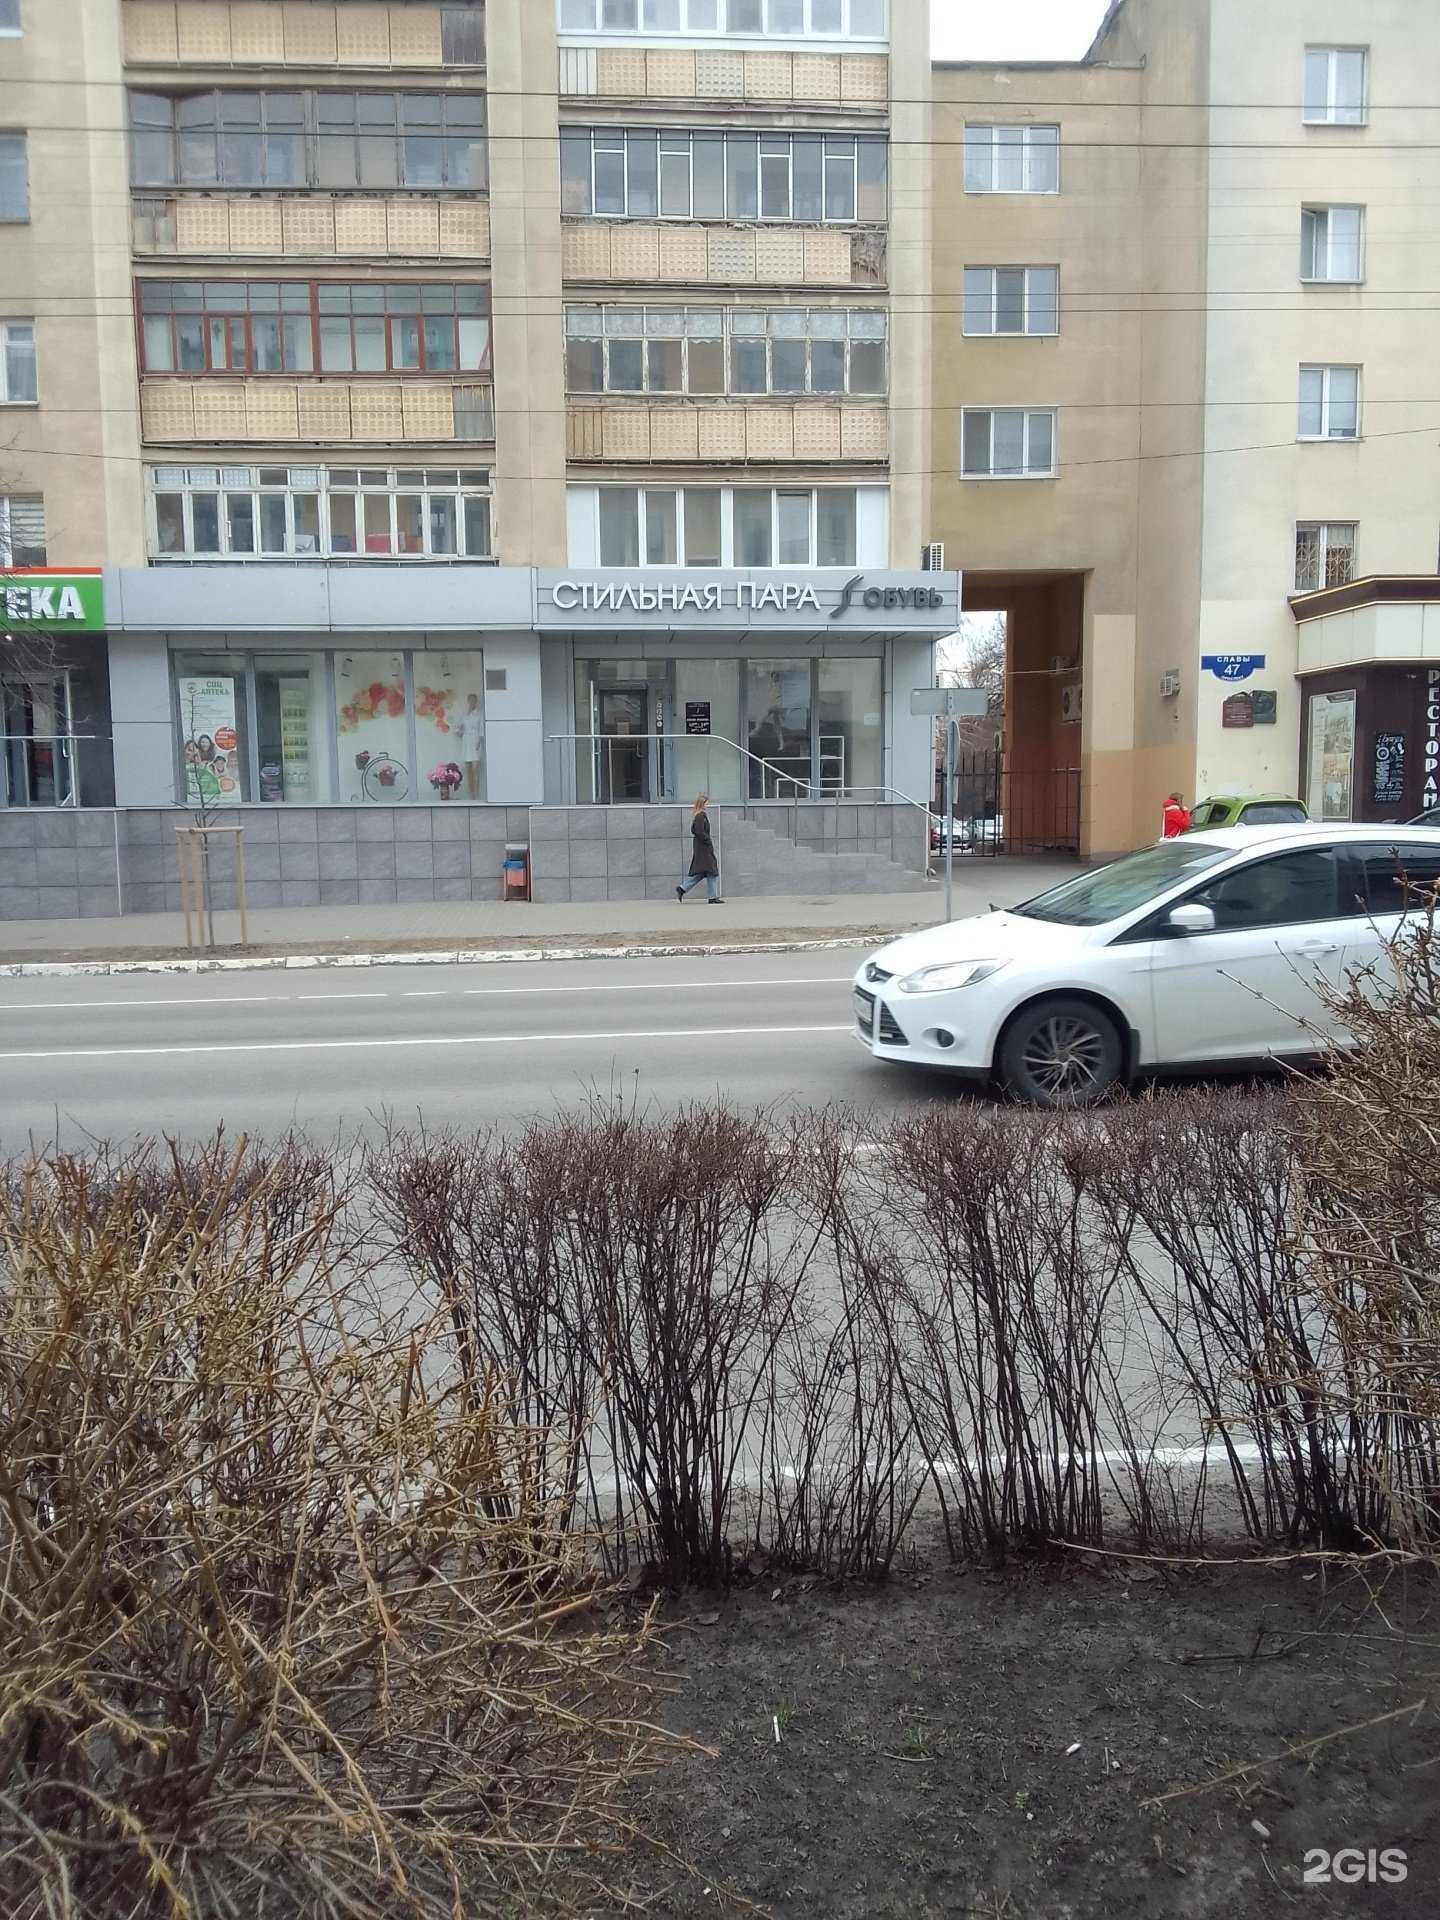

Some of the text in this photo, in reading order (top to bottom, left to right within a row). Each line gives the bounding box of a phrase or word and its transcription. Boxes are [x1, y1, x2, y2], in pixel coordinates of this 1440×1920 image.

[553, 582, 944, 611] СТИЛЬНАЯ ПАРА ОБУВЬ
[1224, 664, 1241, 675] 47
[201, 688, 231, 696] АПТЕКА
